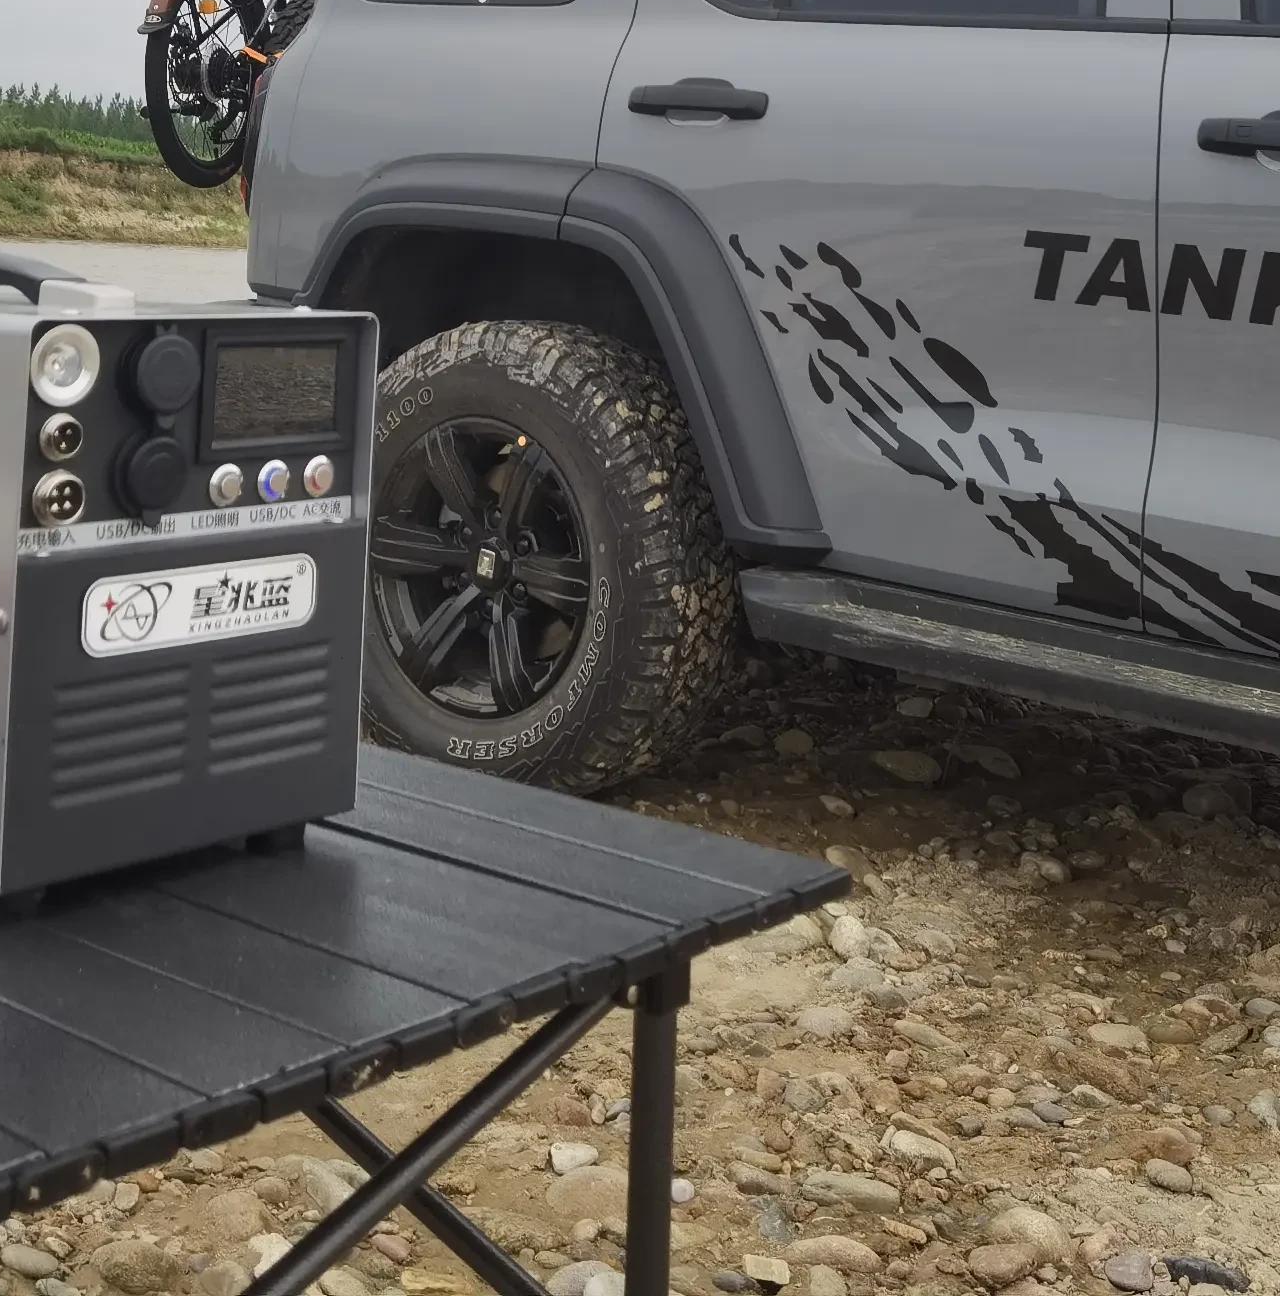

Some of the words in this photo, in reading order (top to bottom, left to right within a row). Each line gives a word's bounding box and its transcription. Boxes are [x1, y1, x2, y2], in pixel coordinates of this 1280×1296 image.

[375, 386, 433, 442] 1100
[191, 510, 239, 530] LED照明
[249, 505, 298, 523] USB/DC
[303, 498, 342, 517] AC交流
[447, 576, 611, 760] COMFORSER
